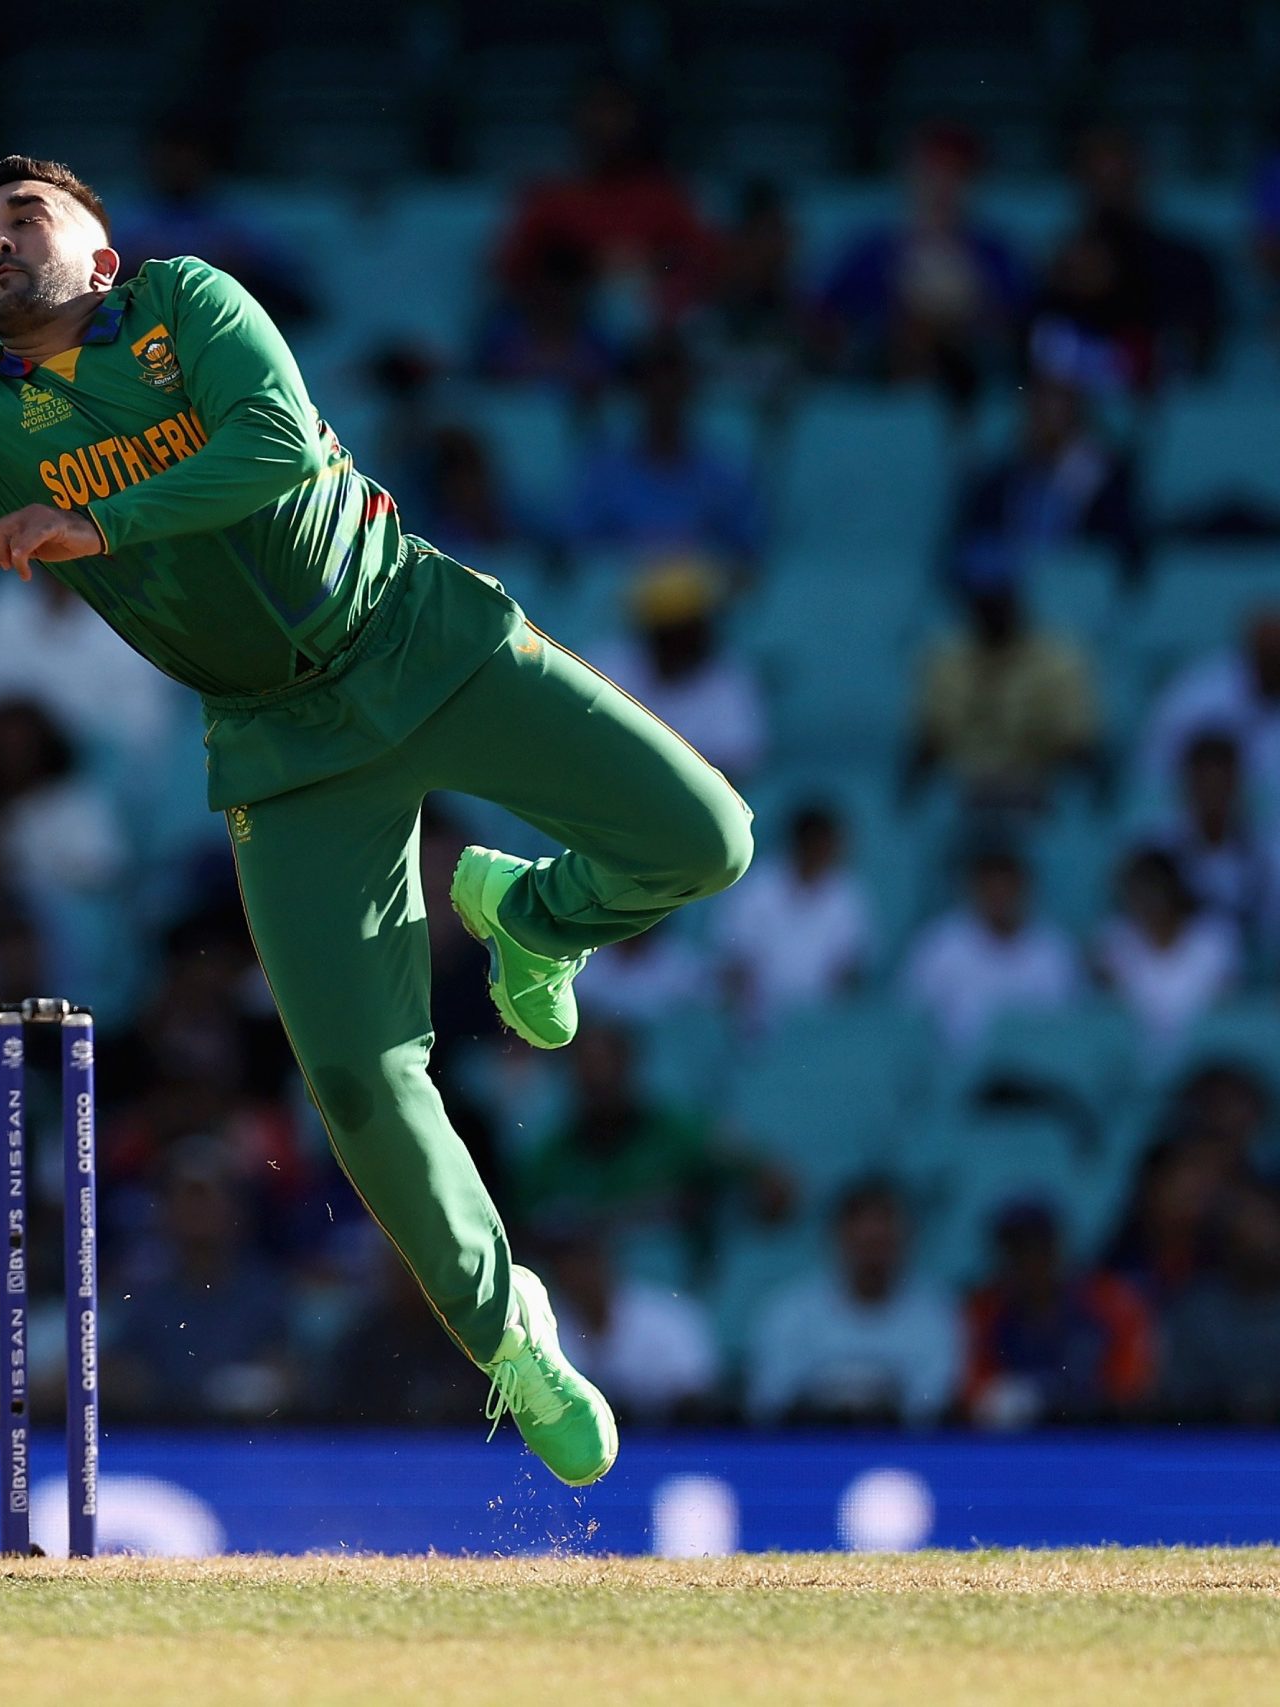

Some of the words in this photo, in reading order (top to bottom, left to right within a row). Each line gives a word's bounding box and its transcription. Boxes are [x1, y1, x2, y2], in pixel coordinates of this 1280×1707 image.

[21, 410, 55, 428] WORLD
[23, 402, 51, 419] MEN'S
[29, 417, 59, 434] AUSTRALIA
[39, 435, 151, 510] SOUTH
[9, 1090, 22, 1197] NISSAN
[77, 1092, 92, 1173] aramco
[78, 1186, 94, 1298] Booking.com
[11, 1308, 24, 1400] ISSAN
[81, 1310, 96, 1391] aramco
[11, 1428, 26, 1490] BYJU'S
[82, 1404, 98, 1516] Booking.com
